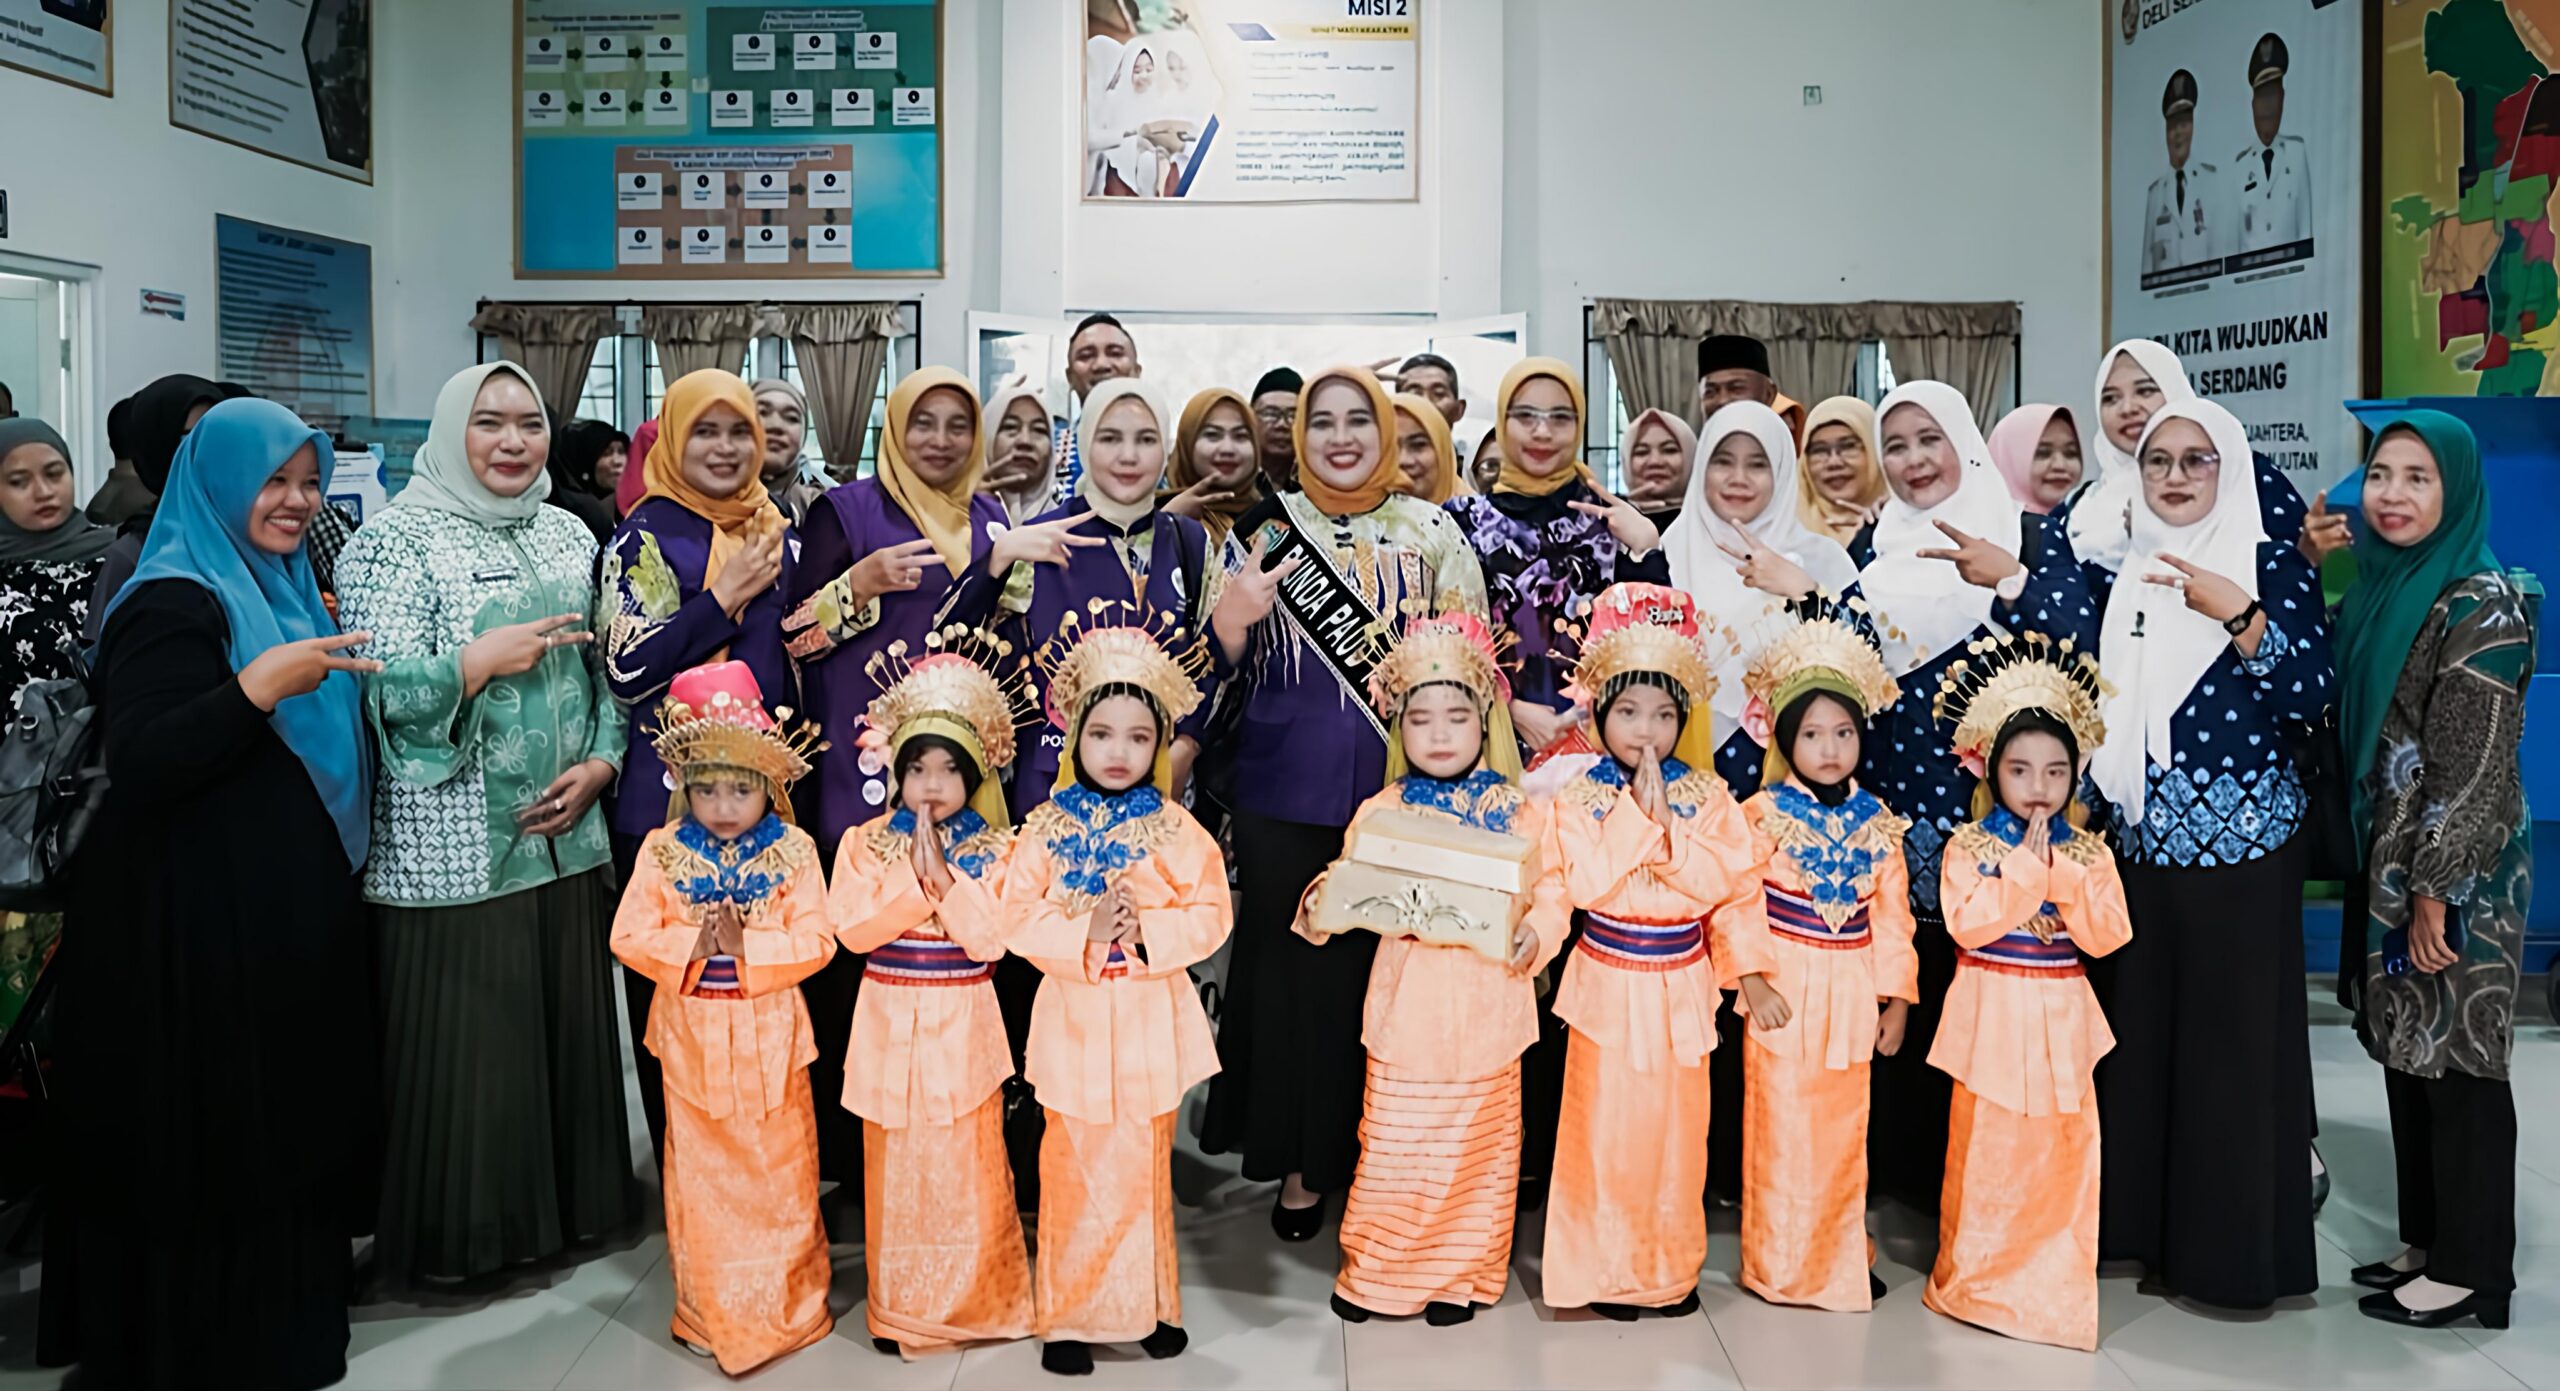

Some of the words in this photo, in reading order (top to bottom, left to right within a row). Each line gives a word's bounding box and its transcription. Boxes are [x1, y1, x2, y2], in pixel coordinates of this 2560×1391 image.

[1348, 0, 1390, 16] MISI
[1396, 0, 1407, 16] 2
[2175, 328, 2212, 356] KITA
[2217, 311, 2328, 351] WUJUDKAN
[2201, 362, 2287, 396] SERDANG
[2243, 422, 2309, 442] JAHTERA,
